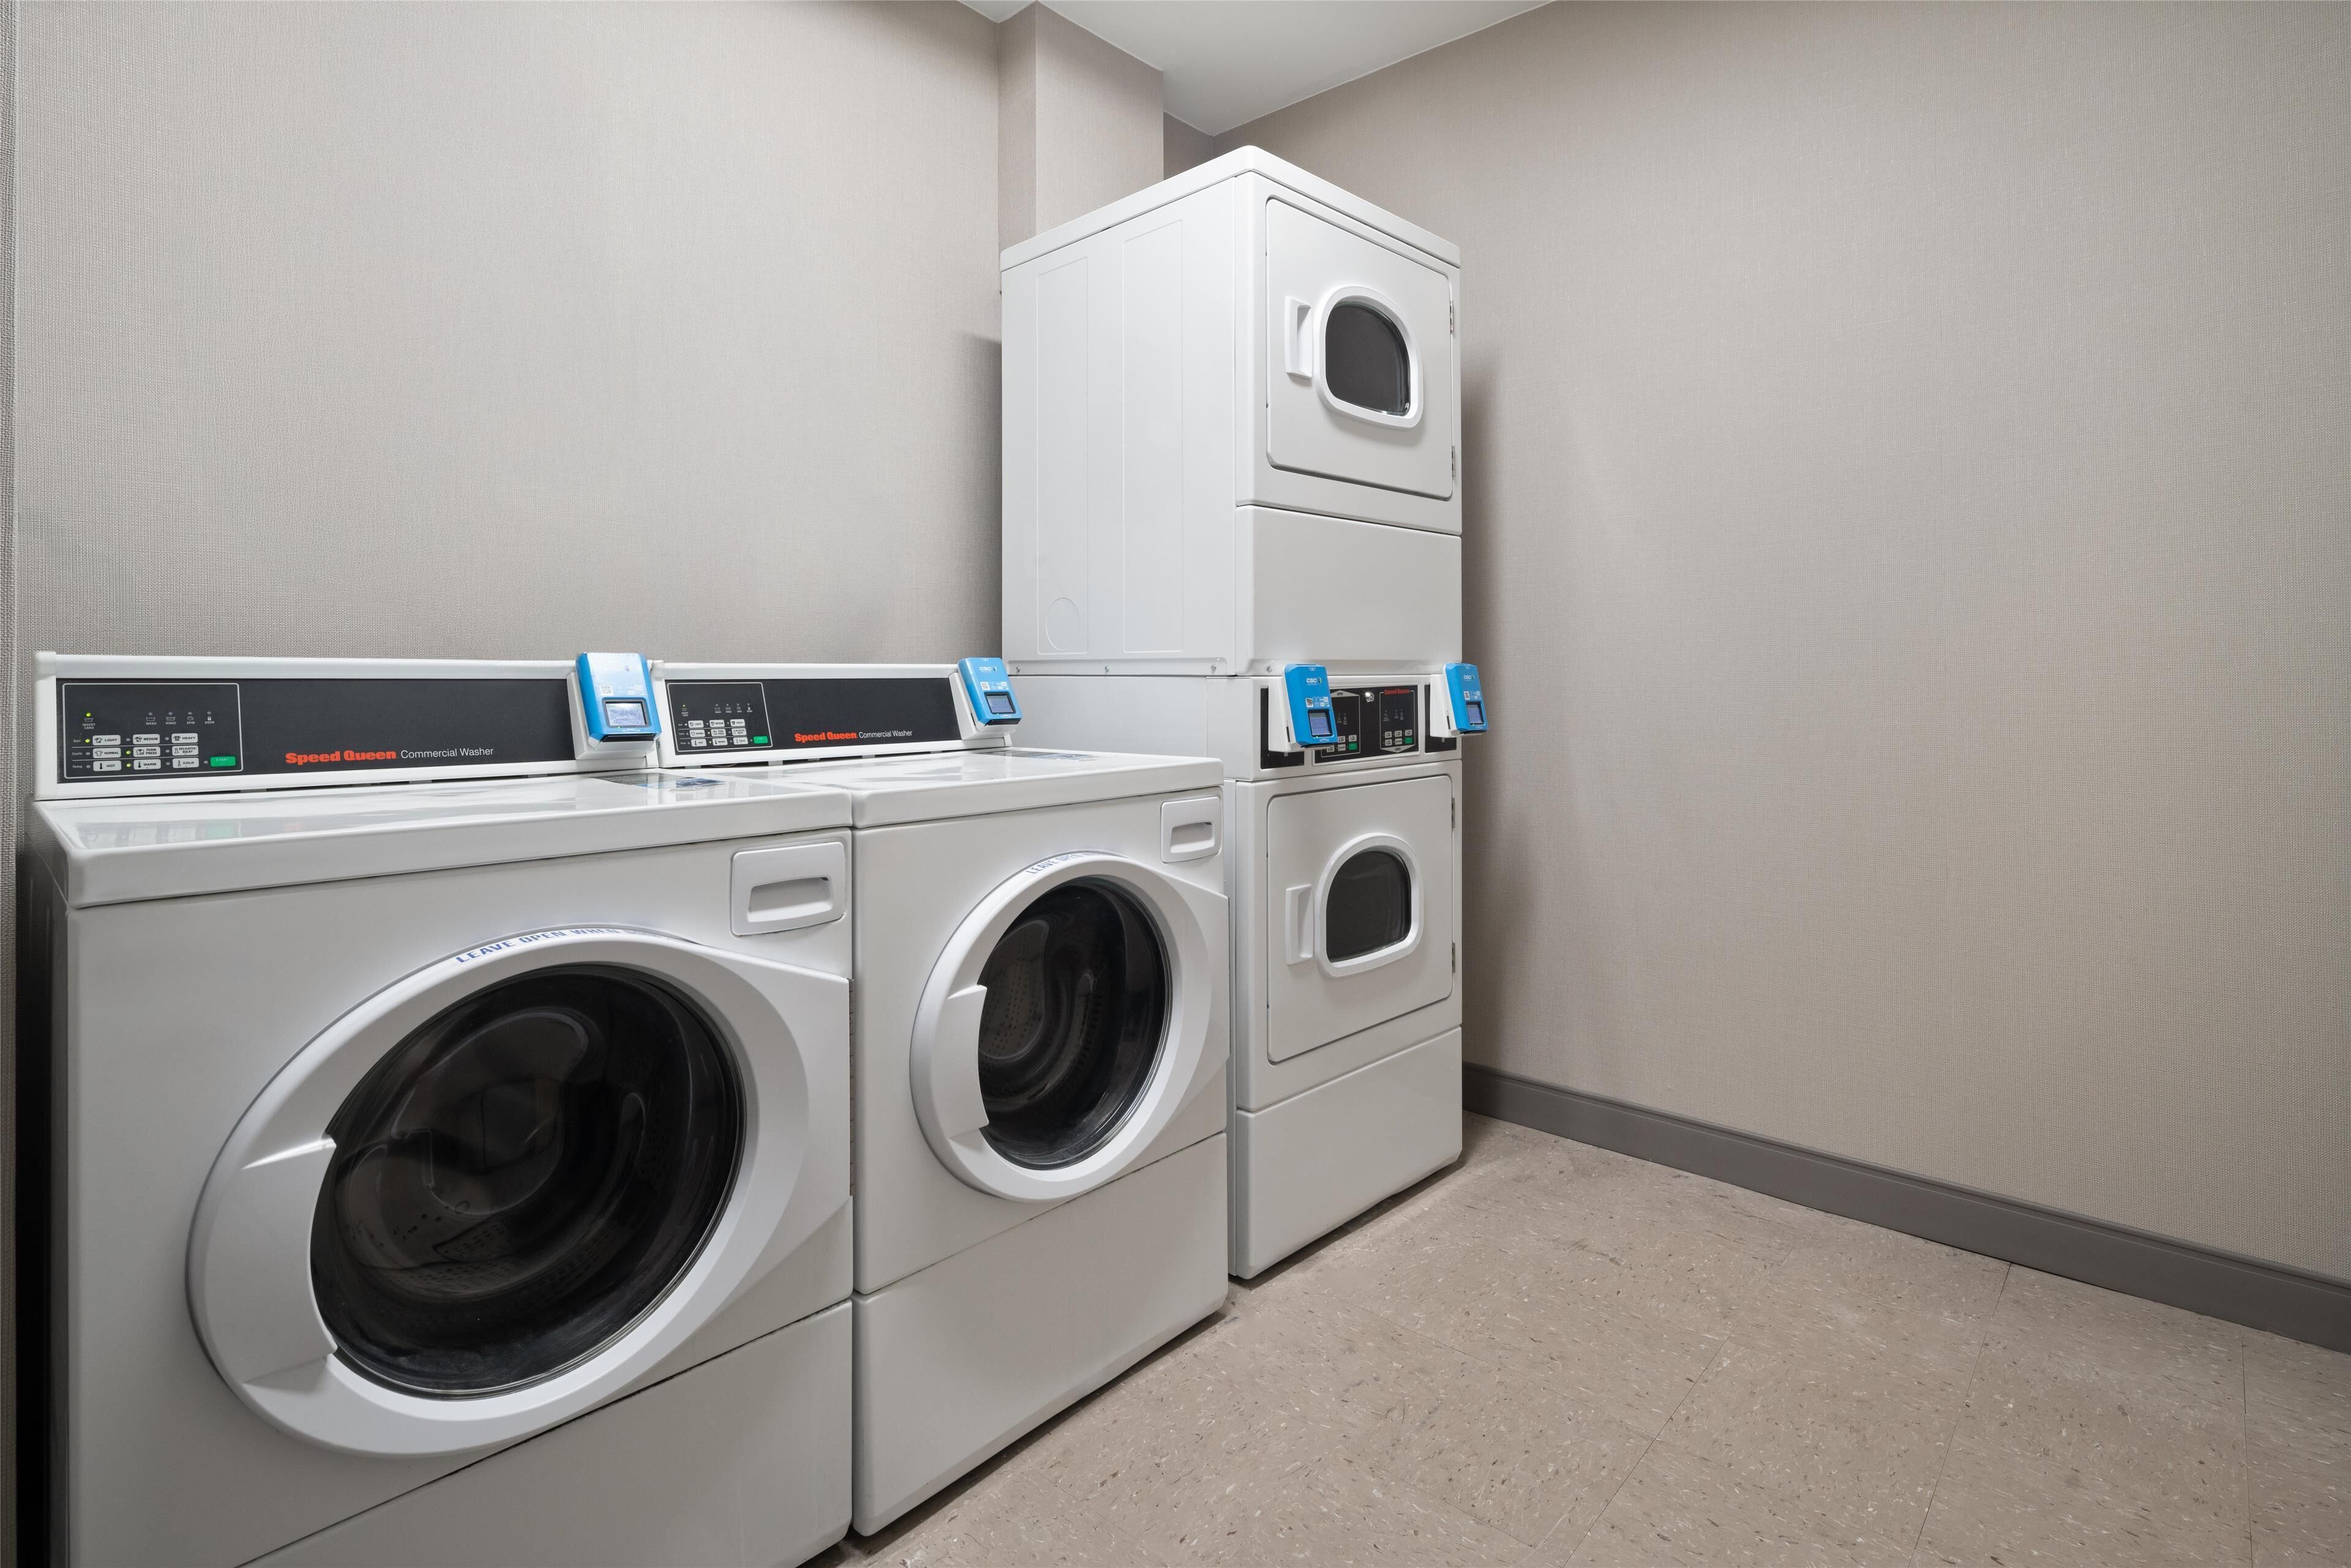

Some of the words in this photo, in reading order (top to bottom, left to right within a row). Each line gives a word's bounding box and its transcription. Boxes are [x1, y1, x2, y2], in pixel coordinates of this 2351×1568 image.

[795, 732, 827, 743] Speed
[827, 731, 857, 740] Queen
[858, 730, 892, 739] Commercial
[285, 751, 341, 765] Speed
[343, 750, 397, 761] Queen
[400, 748, 457, 759] Commercial
[460, 747, 494, 757] Washer
[1026, 860, 1060, 874] LEAVE
[456, 940, 516, 963] LEAVE
[519, 931, 568, 943] OPEN
